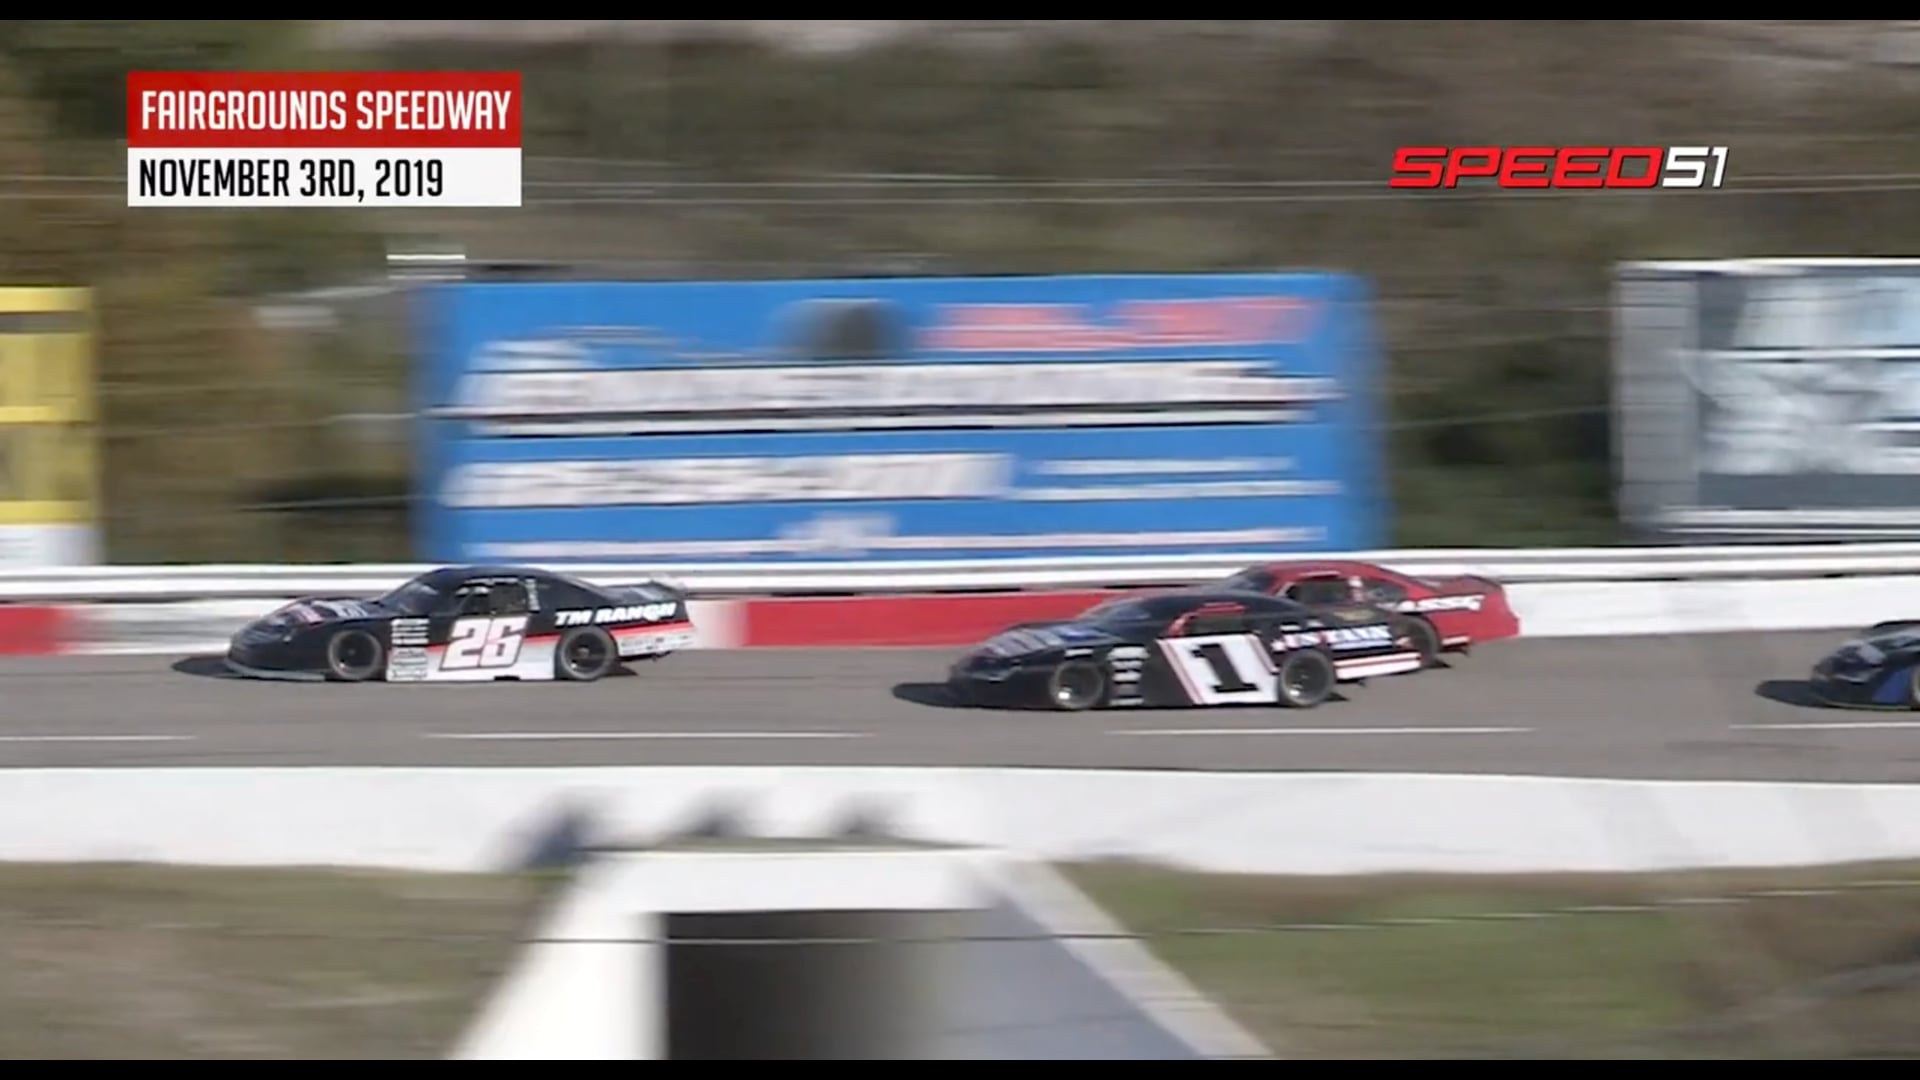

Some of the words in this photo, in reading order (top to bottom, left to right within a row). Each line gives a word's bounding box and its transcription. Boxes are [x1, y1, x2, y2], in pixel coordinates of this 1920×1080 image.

[554, 609, 593, 626] TM
[594, 602, 677, 623] RANCH
[440, 615, 528, 669] 26
[1191, 642, 1260, 692] 1
